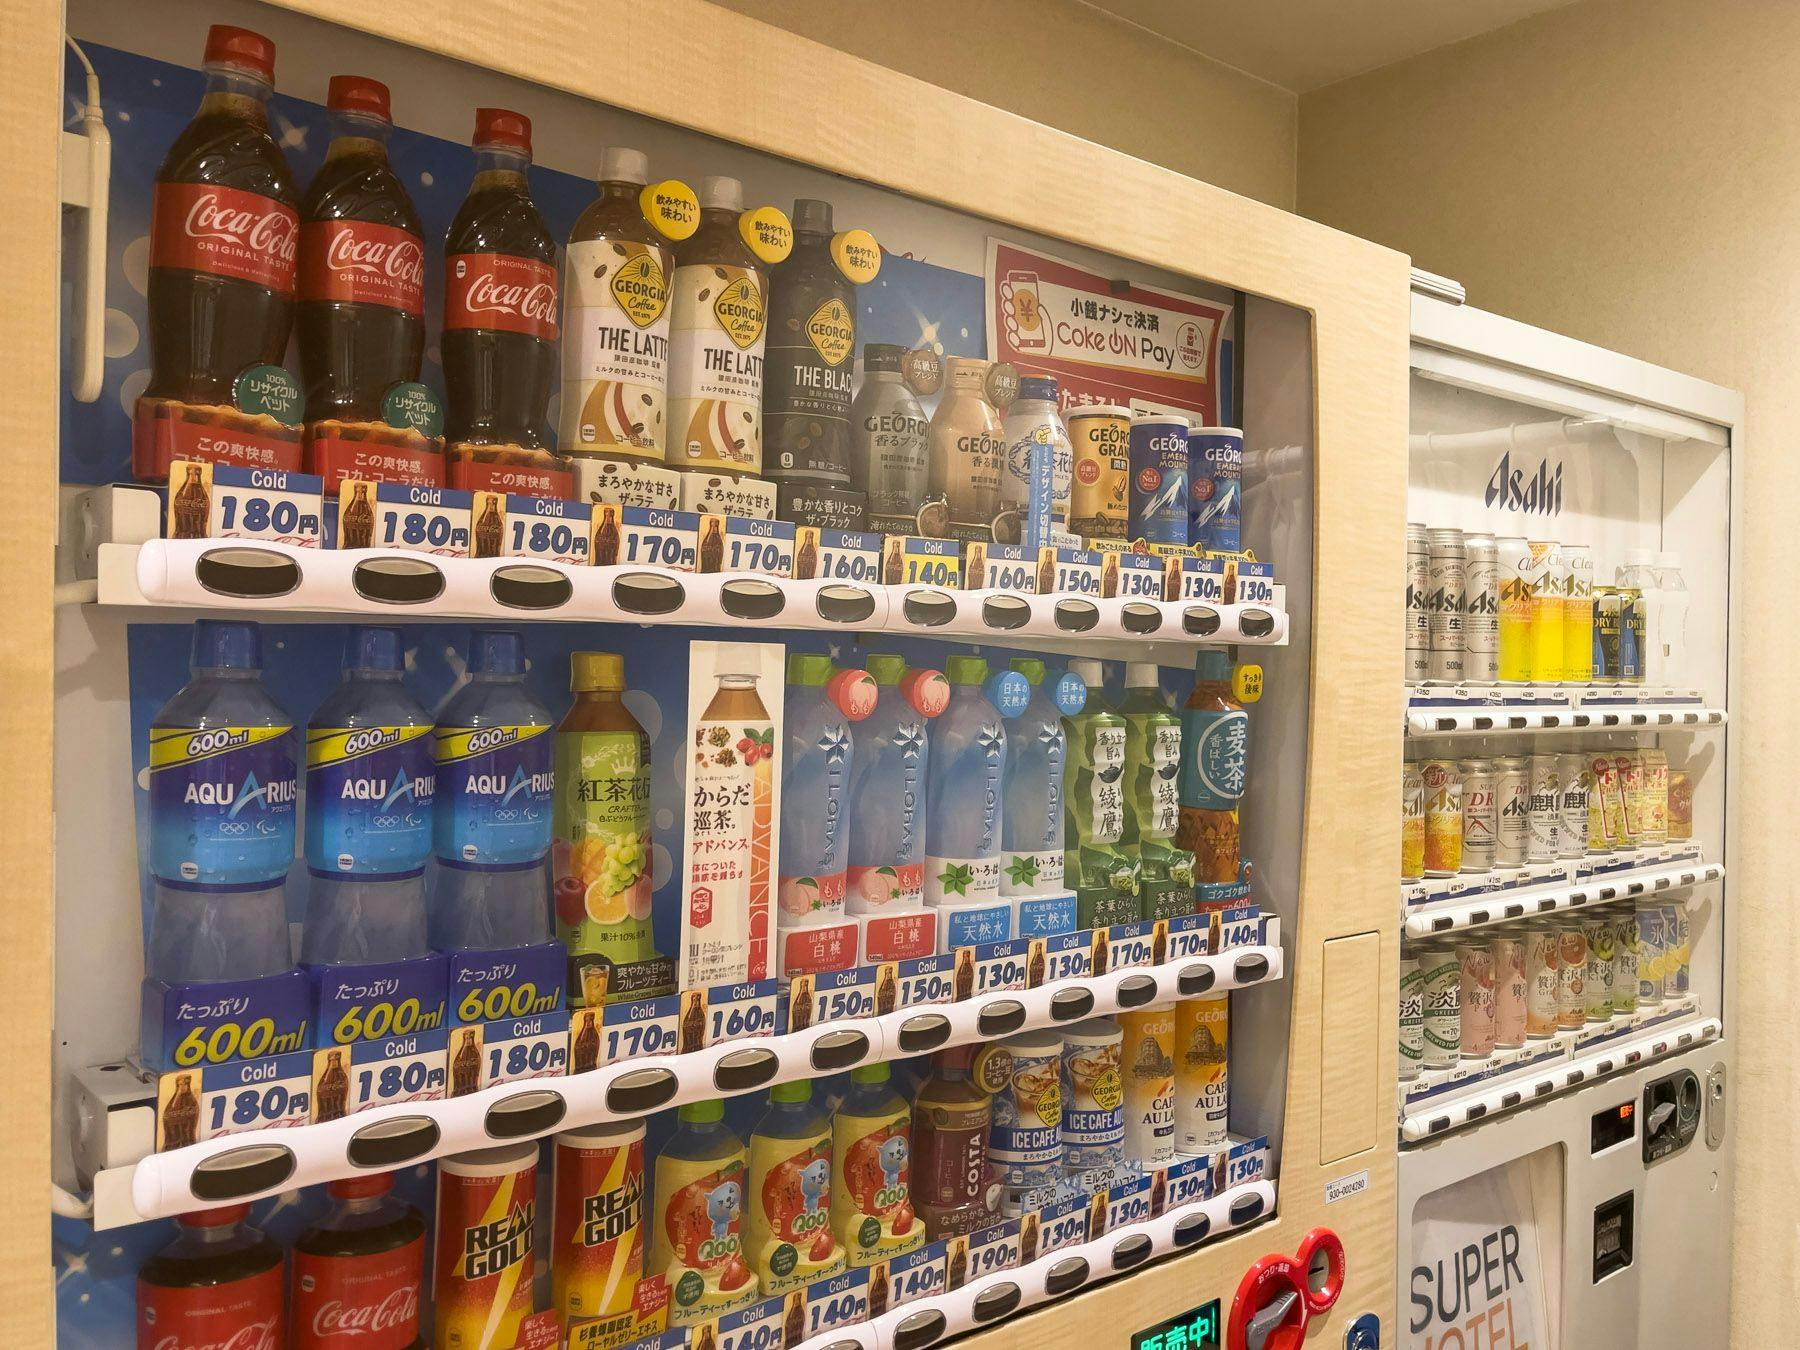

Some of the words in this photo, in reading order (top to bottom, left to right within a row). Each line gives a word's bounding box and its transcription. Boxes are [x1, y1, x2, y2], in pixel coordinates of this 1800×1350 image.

[656, 194, 697, 213] 飲みやすい
[661, 207, 693, 224] 味わい
[755, 220, 791, 238] 飲みやすい
[759, 232, 787, 249] 味わい
[197, 241, 260, 263] ORIGINAL
[263, 254, 291, 272] TASTE
[845, 244, 878, 260] 飲みやすい
[849, 256, 875, 270] 味わい
[340, 273, 396, 290] ORIGINAL
[398, 283, 422, 297] TASTE
[615, 279, 666, 303] GEORGIA
[628, 297, 657, 312] Coffee
[717, 302, 763, 324] GEORGIA
[1070, 297, 1160, 334] 小銭ナシで決済
[730, 319, 757, 333] Coffee
[810, 323, 853, 342] GEORGIA
[821, 338, 847, 351] Coffee
[1057, 321, 1105, 352] Coke
[1109, 327, 1137, 359] ON
[1141, 336, 1175, 371] Pay
[703, 348, 734, 373] THE
[794, 365, 822, 388] THE
[250, 379, 298, 401] リサイクル
[260, 394, 291, 414] ペット
[395, 396, 438, 415] リサイクル
[404, 410, 431, 426] ペット
[196, 436, 280, 465] この爽快感。
[355, 452, 428, 475] この爽快感。
[251, 470, 287, 490] Cold
[597, 474, 673, 498] まろやかな甘さ
[1484, 450, 1563, 517] Asahi
[536, 501, 563, 518] Cold
[704, 487, 771, 510] まろやかな甘さ
[792, 496, 863, 516] 豊かな香りとコク
[221, 495, 319, 536] 180円
[383, 511, 469, 548] 180円
[512, 520, 588, 556] 180円
[750, 522, 773, 537] Cold
[627, 533, 696, 566] 170円
[731, 540, 791, 572] 170円
[924, 541, 943, 555] Cold
[1072, 551, 1089, 564] Cold
[823, 553, 877, 582] 160円
[909, 560, 958, 587] 140円
[990, 565, 1035, 590] 160円
[1197, 560, 1212, 572] Cold
[1059, 569, 1100, 593] 150円
[1122, 573, 1160, 596] 130円
[1185, 576, 1221, 599] 130円
[1240, 580, 1273, 602] 130円
[1417, 616, 1428, 628] 生
[1449, 618, 1462, 630] 生
[1002, 696, 1028, 708] 天然水
[1061, 694, 1086, 706] 天然水
[187, 730, 249, 755] 600ml
[345, 729, 400, 755] 600ml
[467, 728, 518, 752] 600ml
[1209, 733, 1224, 780] 香ばしい
[1221, 721, 1247, 792] 麦茶
[184, 770, 296, 820] AQUARIUS
[465, 764, 555, 808] AQUARIUS
[694, 784, 751, 808] からだ
[1099, 787, 1119, 839] 綾鷹
[1158, 782, 1176, 832] 綾鷹
[1550, 826, 1559, 837] 生
[692, 838, 748, 856] アドバンス
[962, 920, 1003, 942] 天然水
[1033, 909, 1071, 931] 天然水
[1182, 917, 1197, 930] Cold
[893, 928, 920, 945] 白桃
[1063, 936, 1079, 949] Cold
[1170, 933, 1208, 958] 170円
[1223, 924, 1258, 948] 140円
[812, 940, 841, 959] 白桃
[1111, 941, 1151, 968] 170円
[457, 964, 517, 984] たっぷり
[918, 958, 937, 974] Cold
[978, 961, 1026, 990] 130円
[1049, 953, 1092, 980] 130円
[1461, 955, 1490, 976] New
[335, 979, 400, 1001] たっぷり
[732, 983, 756, 1000] Cold
[901, 975, 952, 1005] 150円
[177, 997, 249, 1020] たっぷり
[458, 982, 560, 1023] 600ml
[818, 990, 873, 1022] 150円
[333, 998, 446, 1045] 600ml
[513, 1018, 542, 1038] Cold
[712, 1004, 775, 1039] 160円
[174, 1018, 307, 1067] 600ml
[607, 1024, 678, 1061] 170円
[489, 1041, 567, 1080] 180円
[240, 1066, 278, 1083] Cold
[359, 1061, 446, 1104] 180円
[1454, 1070, 1467, 1080] ¥210
[1414, 1082, 1429, 1091] ¥210
[210, 1085, 310, 1131] 180円
[1069, 1113, 1087, 1130] ICE
[1088, 1112, 1112, 1130] CAFE
[1012, 1132, 1031, 1149] ICE
[1032, 1129, 1056, 1148] CAFE
[1241, 1140, 1256, 1155] Cold
[966, 1132, 983, 1198] COSTA
[1085, 1168, 1116, 1185] ミルクの
[1229, 1155, 1264, 1184] 130円
[874, 1183, 908, 1208] Qoo
[1029, 1187, 1058, 1206] ミルクの
[1123, 1182, 1139, 1197] Cold
[1168, 1176, 1206, 1205] 130円
[791, 1210, 829, 1234] Qoo
[940, 1208, 985, 1226] なめらかな
[1110, 1197, 1150, 1228] 130円
[465, 1200, 535, 1254] REAL
[987, 1226, 1005, 1243] Cold
[1042, 1217, 1084, 1250] 130円
[699, 1233, 739, 1260] Qoo
[971, 1243, 1018, 1276] 190円
[342, 1273, 385, 1286] ORIGINAL
[829, 1280, 850, 1294] Cold
[894, 1265, 944, 1302] 140円
[1410, 1224, 1524, 1334] SUPER
[811, 1294, 867, 1332] 140円
[1140, 1316, 1209, 1350] 販売中
